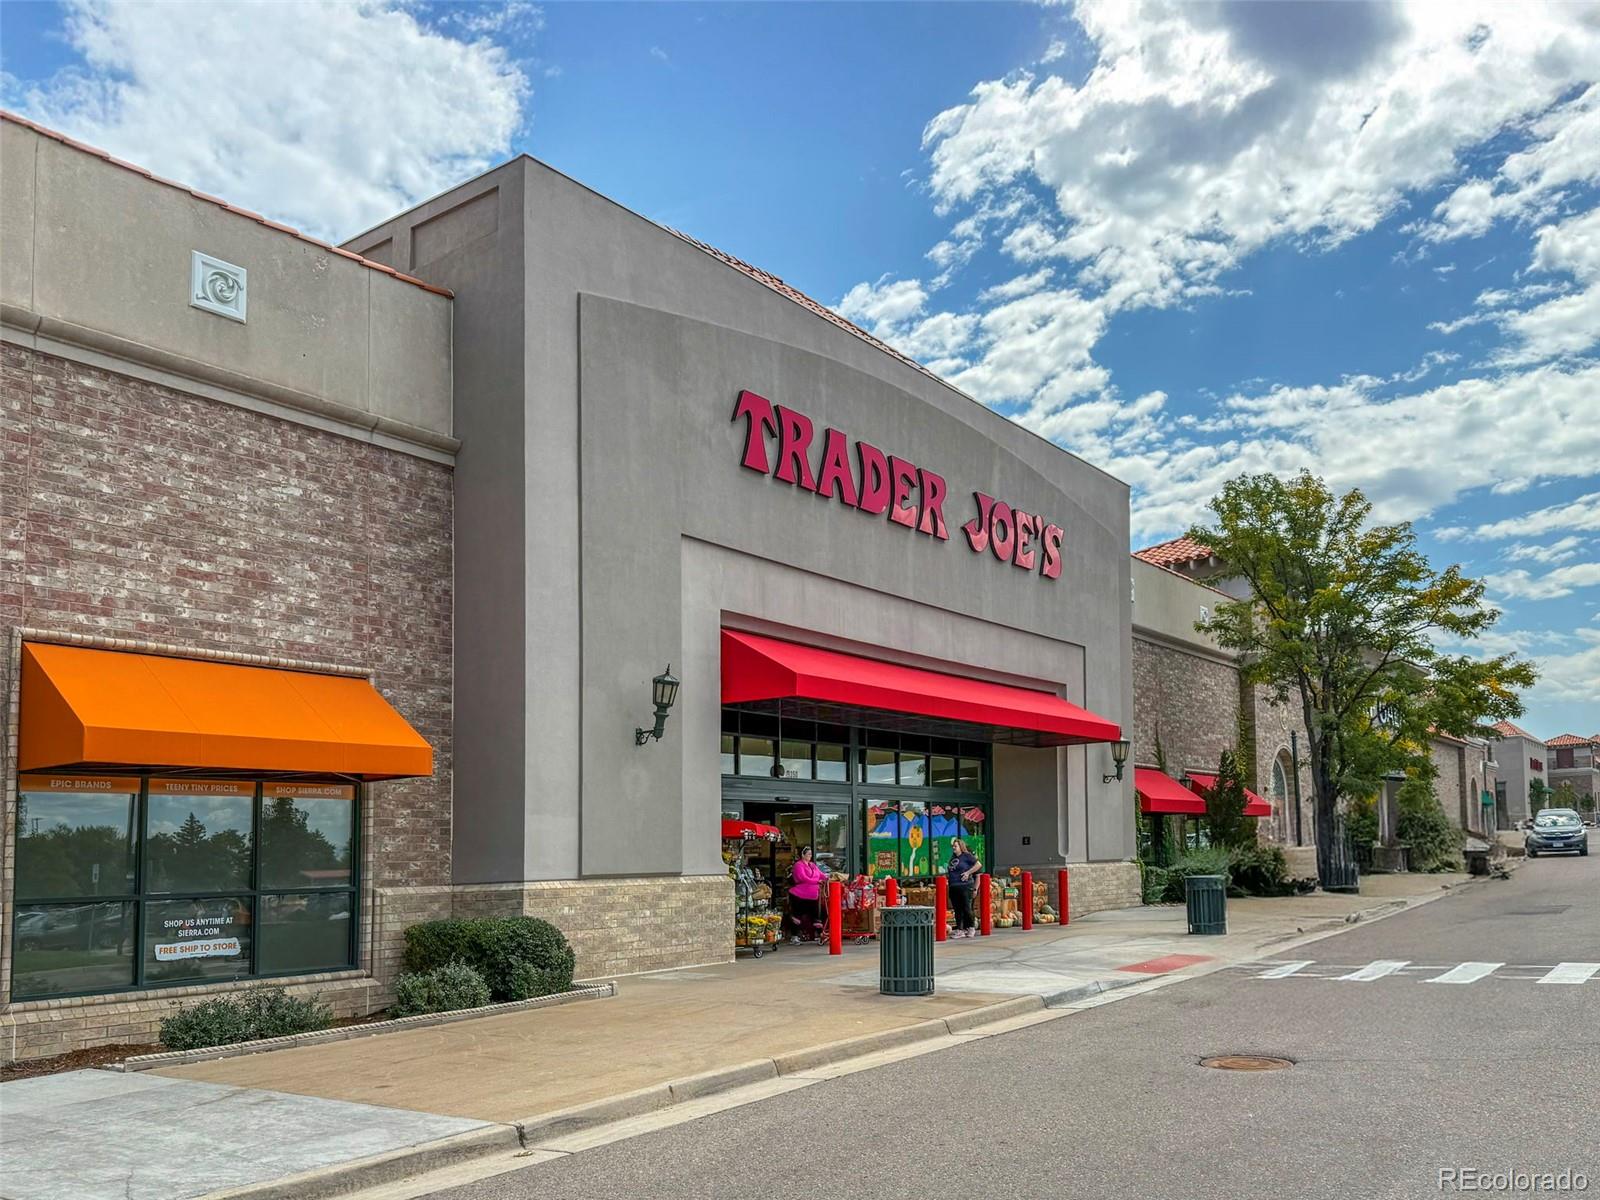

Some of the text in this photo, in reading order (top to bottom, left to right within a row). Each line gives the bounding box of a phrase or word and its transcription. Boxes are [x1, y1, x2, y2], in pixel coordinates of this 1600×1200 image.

[731, 389, 1065, 580] TRADER JOE'S
[50, 779, 112, 789] EPIC BRANDS
[165, 783, 239, 793] TEENY TINY PRICES
[276, 786, 342, 796] SHOP SIERRA.COM
[164, 916, 233, 928] SHOP US ANYTIME AT
[178, 927, 220, 937] SIERRA.COM
[160, 941, 237, 955] FREE SHIP TO STORE
